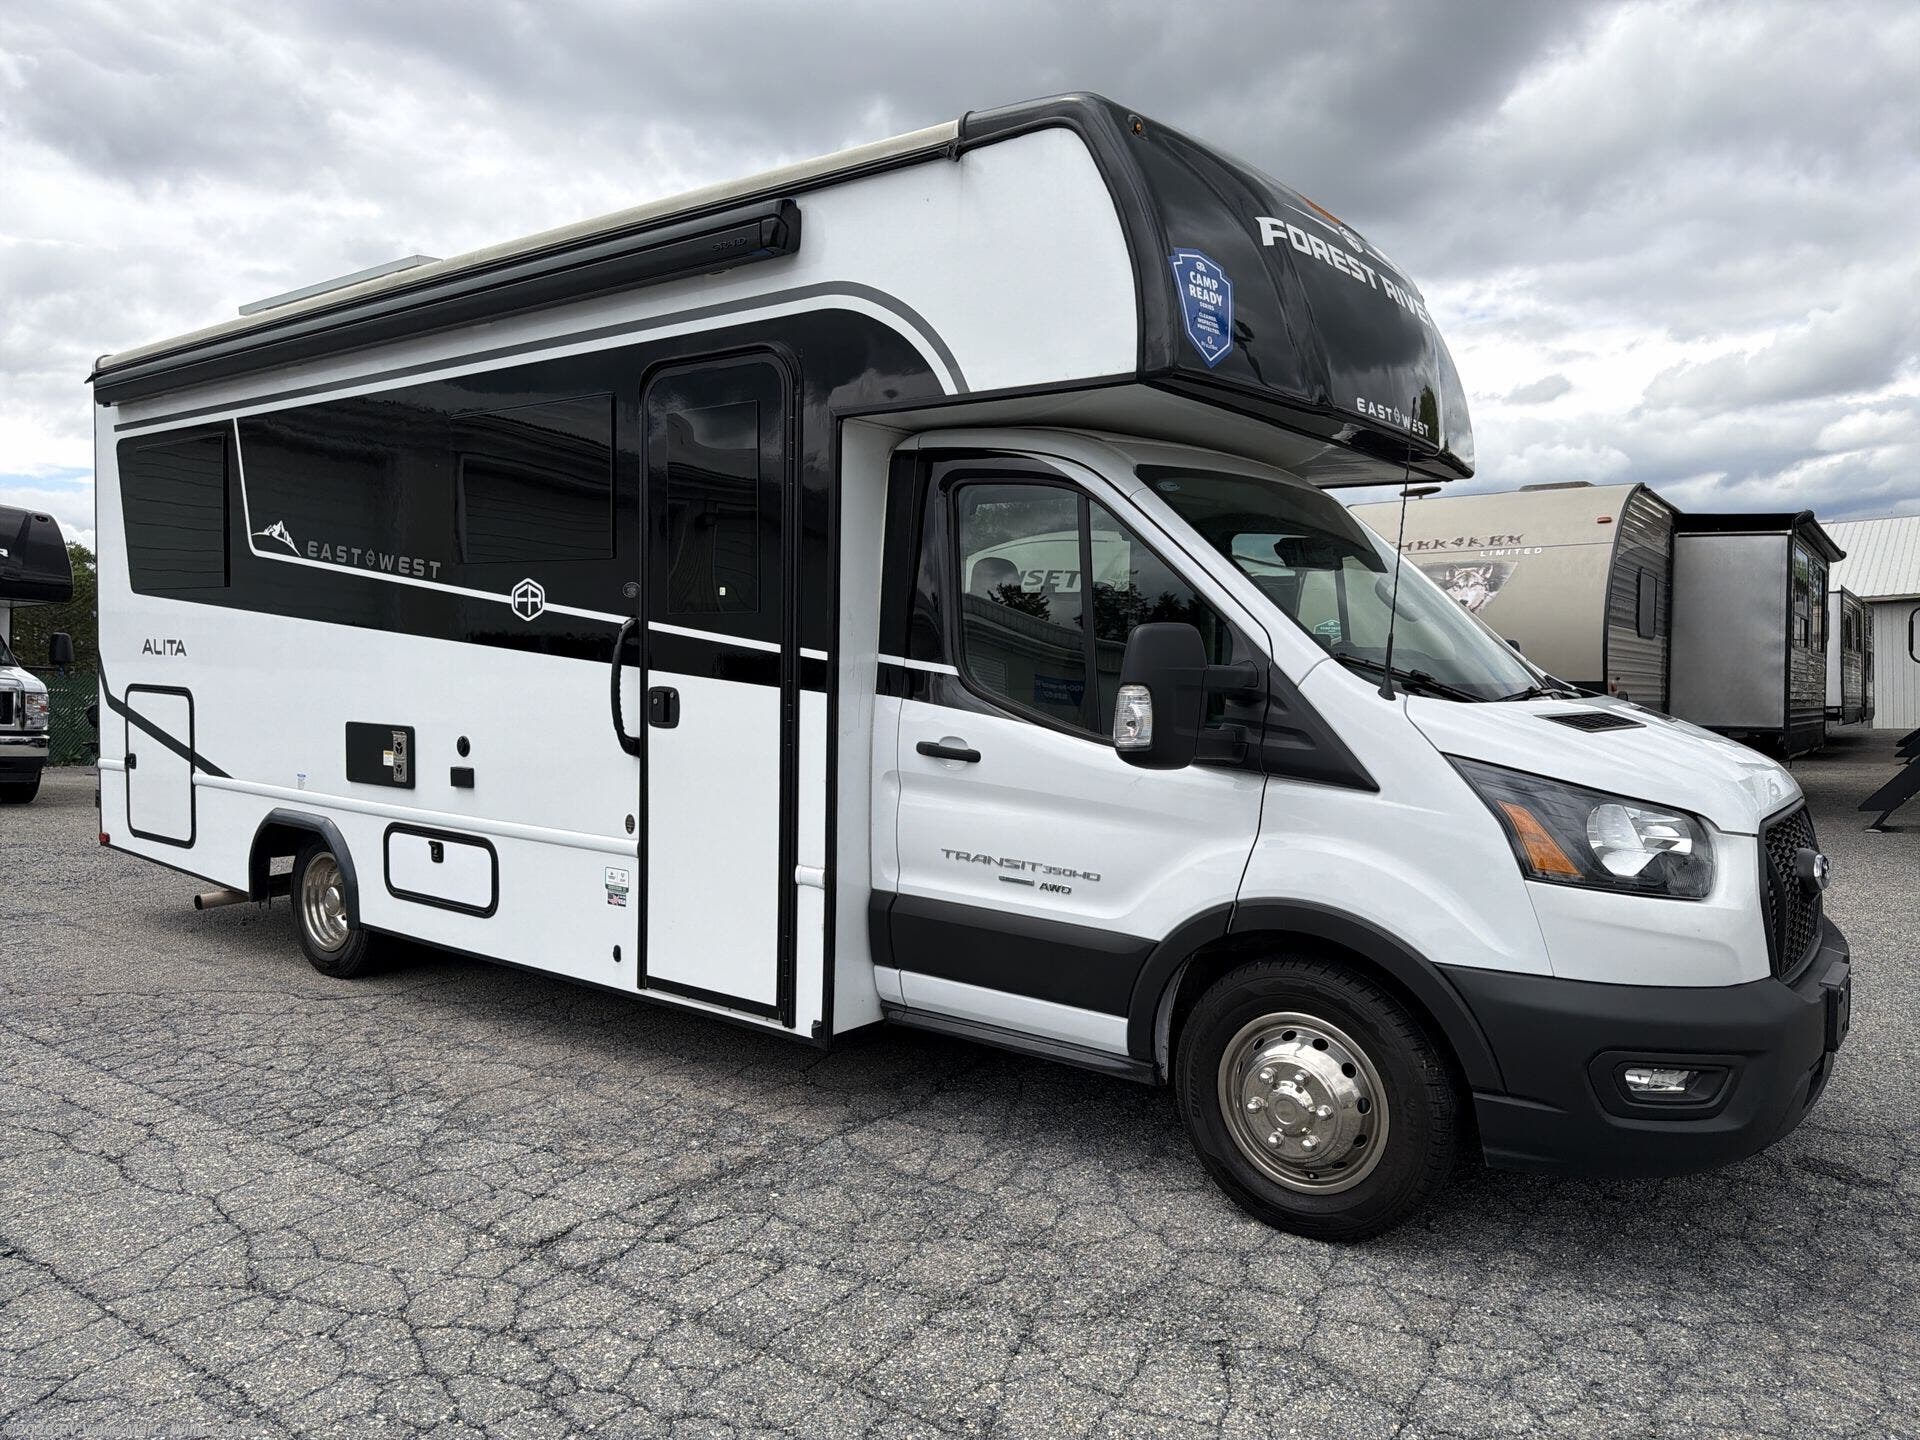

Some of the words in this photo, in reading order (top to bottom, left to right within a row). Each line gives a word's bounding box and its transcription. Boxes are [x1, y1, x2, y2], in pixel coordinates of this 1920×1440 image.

[1189, 271, 1219, 290] CAMP
[1254, 216, 1377, 290] FOREST
[1378, 273, 1433, 328] RIVE
[1188, 284, 1223, 307] READY
[1356, 397, 1393, 422] EAST
[1402, 413, 1430, 438] WEST
[307, 540, 362, 566] EAST
[379, 552, 442, 579] WEST
[1479, 547, 1543, 557] LIMITED
[142, 638, 187, 657] ALITA
[941, 848, 1043, 873] TRANSIT
[1039, 882, 1072, 896] AWD
